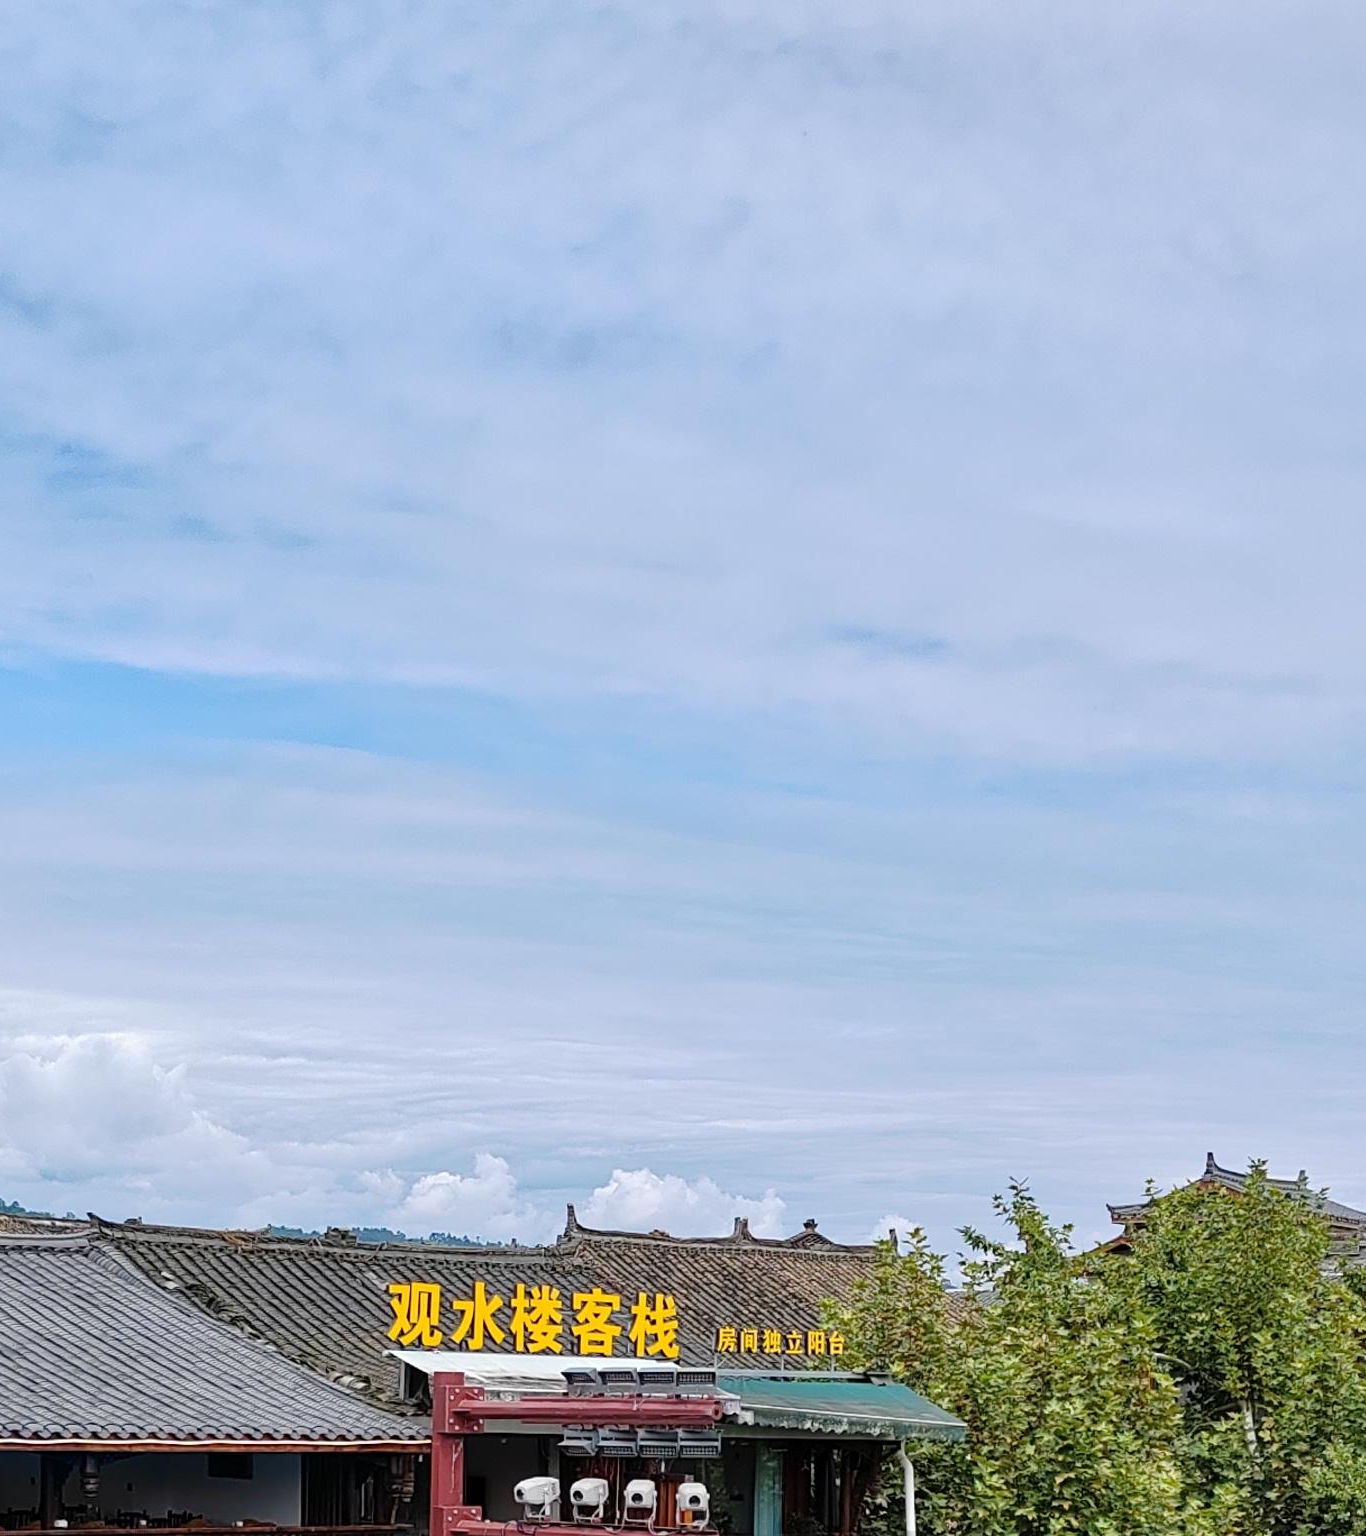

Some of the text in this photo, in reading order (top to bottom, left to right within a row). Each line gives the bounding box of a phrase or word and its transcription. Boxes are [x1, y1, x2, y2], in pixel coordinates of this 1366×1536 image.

[387, 1281, 680, 1358] 观水楼客栈
[718, 1326, 845, 1355] 房间独立阳台
